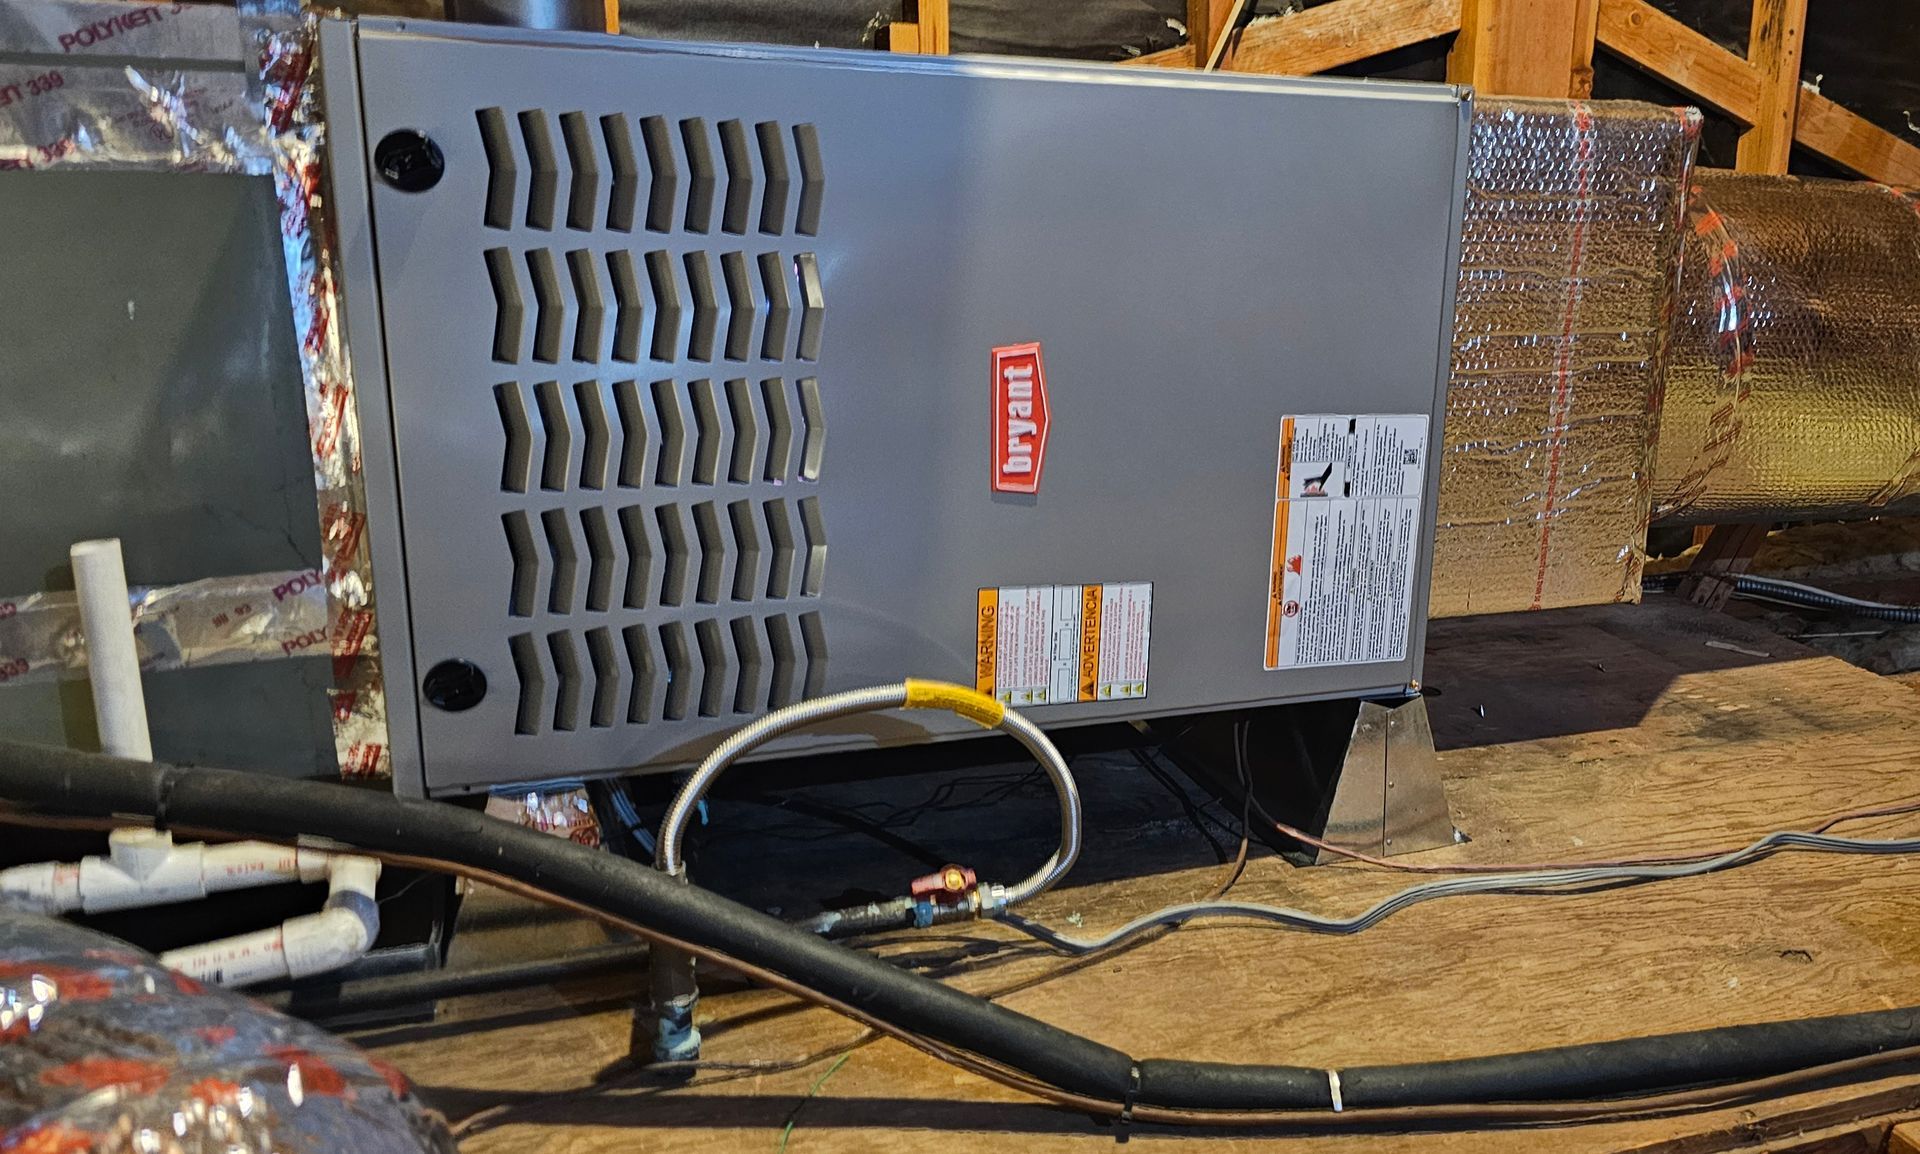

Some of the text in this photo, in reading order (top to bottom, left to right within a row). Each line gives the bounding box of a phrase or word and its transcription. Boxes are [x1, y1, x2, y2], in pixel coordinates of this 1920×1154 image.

[1003, 363, 1037, 474] bryant
[979, 605, 995, 679] WARNING
[1083, 588, 1097, 678] ADVERTENCIA
